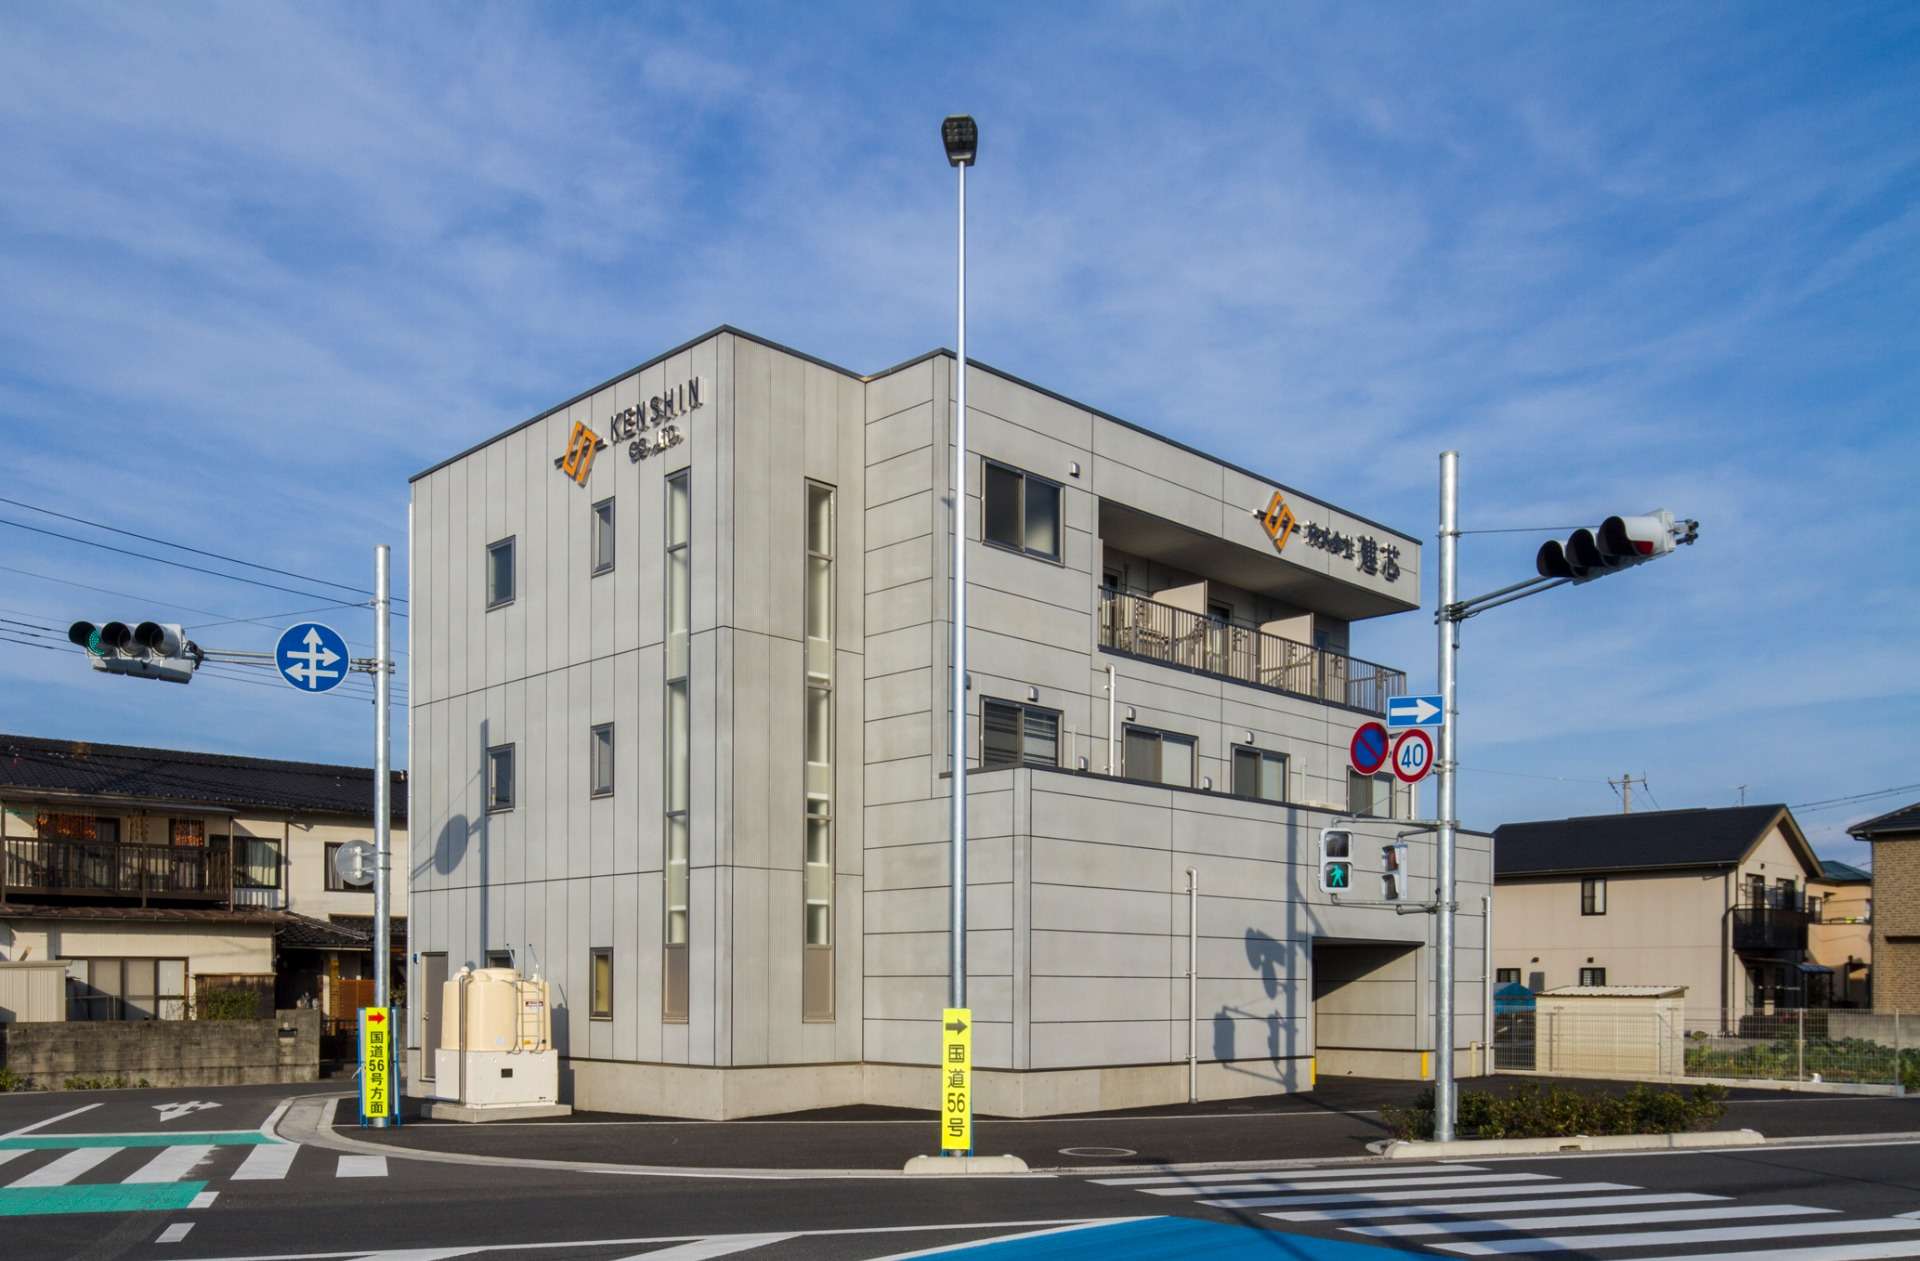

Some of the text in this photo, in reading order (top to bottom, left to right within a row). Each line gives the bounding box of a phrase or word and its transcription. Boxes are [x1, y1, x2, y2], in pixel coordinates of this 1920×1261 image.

[610, 376, 701, 443] KENSHIN
[1401, 743, 1424, 768] 40
[368, 1031, 385, 1114] 国道56号方面
[947, 1044, 966, 1137] 国道56号
